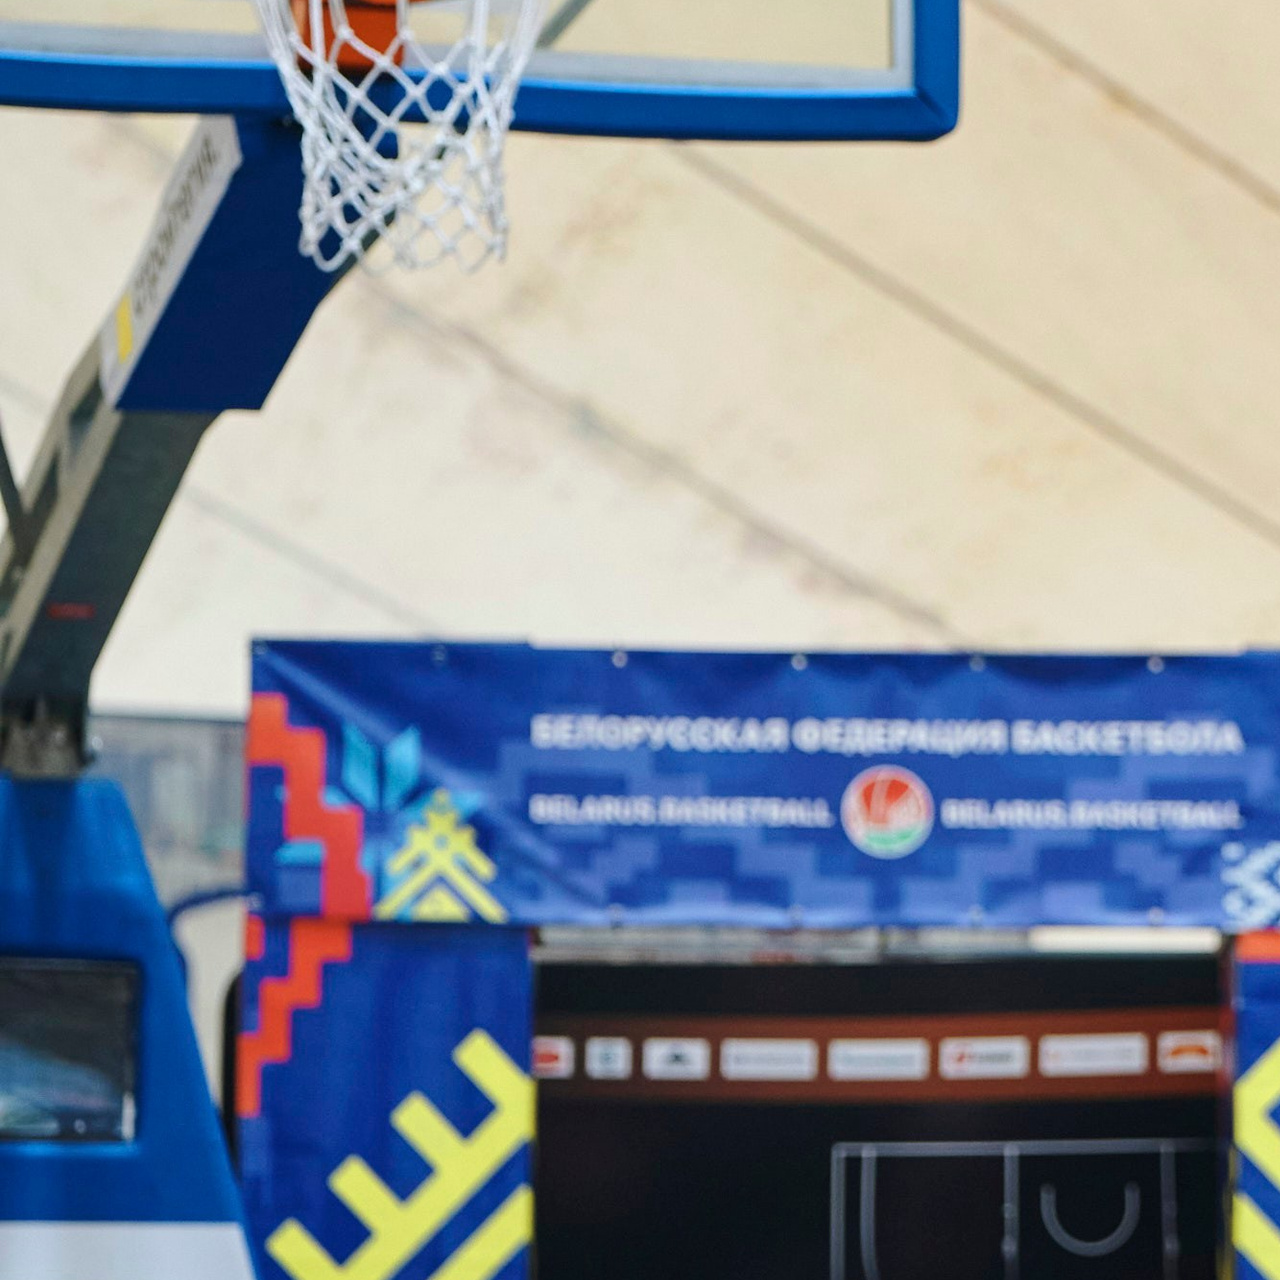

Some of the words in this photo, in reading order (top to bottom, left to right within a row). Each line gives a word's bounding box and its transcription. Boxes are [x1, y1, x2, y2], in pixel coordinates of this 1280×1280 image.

[531, 715, 790, 752] БЕЛОРУССКАЯ
[793, 718, 1008, 757] ФЕДЕРАЦИЯ
[1011, 720, 1244, 755] БАСКЕТБОЛА
